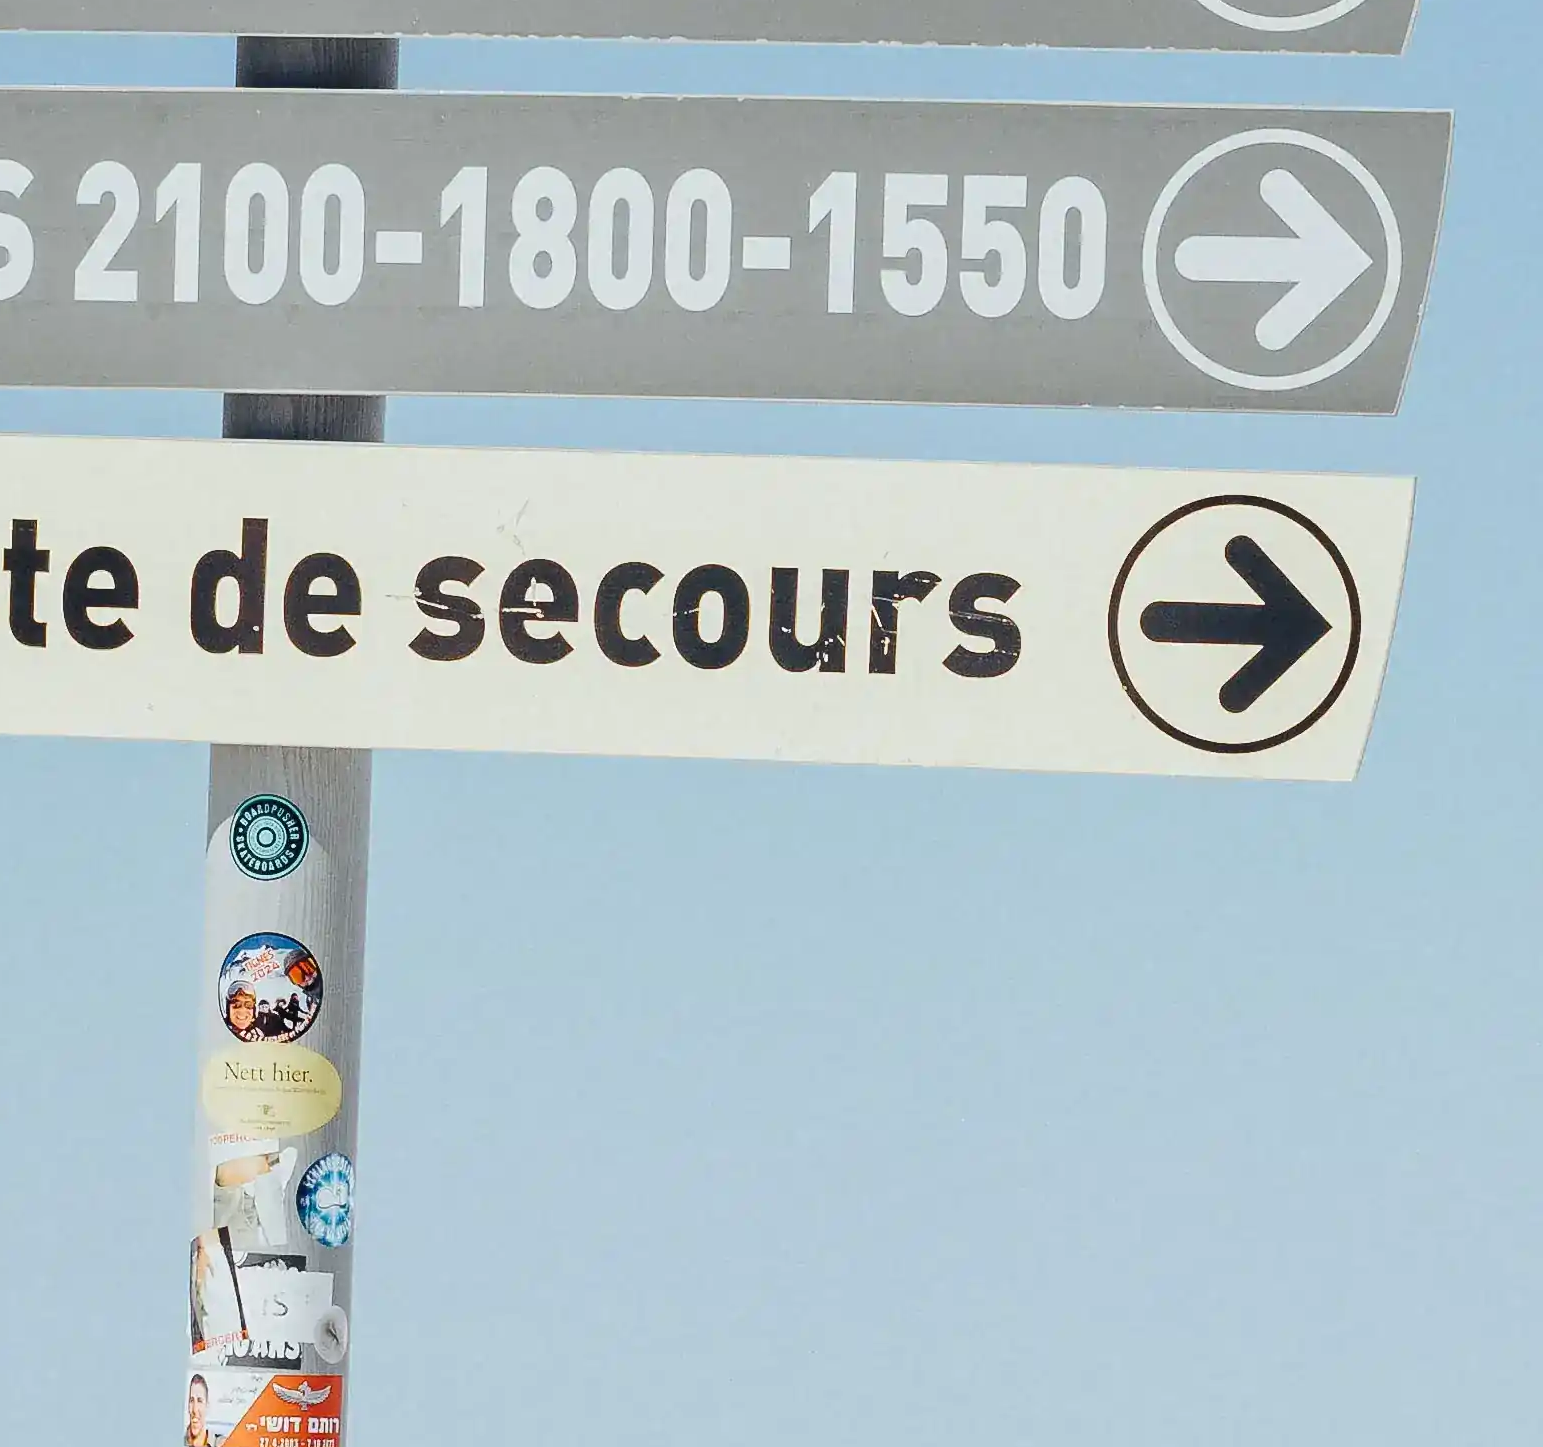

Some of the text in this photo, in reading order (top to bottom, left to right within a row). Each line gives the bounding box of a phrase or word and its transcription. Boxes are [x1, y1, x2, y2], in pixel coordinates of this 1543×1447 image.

[73, 160, 1107, 321] 2100-1800-1550
[190, 516, 362, 659] de
[408, 554, 1023, 679] secours
[240, 804, 300, 840] BOARDPUSHER
[236, 835, 295, 871] SKATEBOARDS
[224, 1061, 313, 1083] Nett hier.
